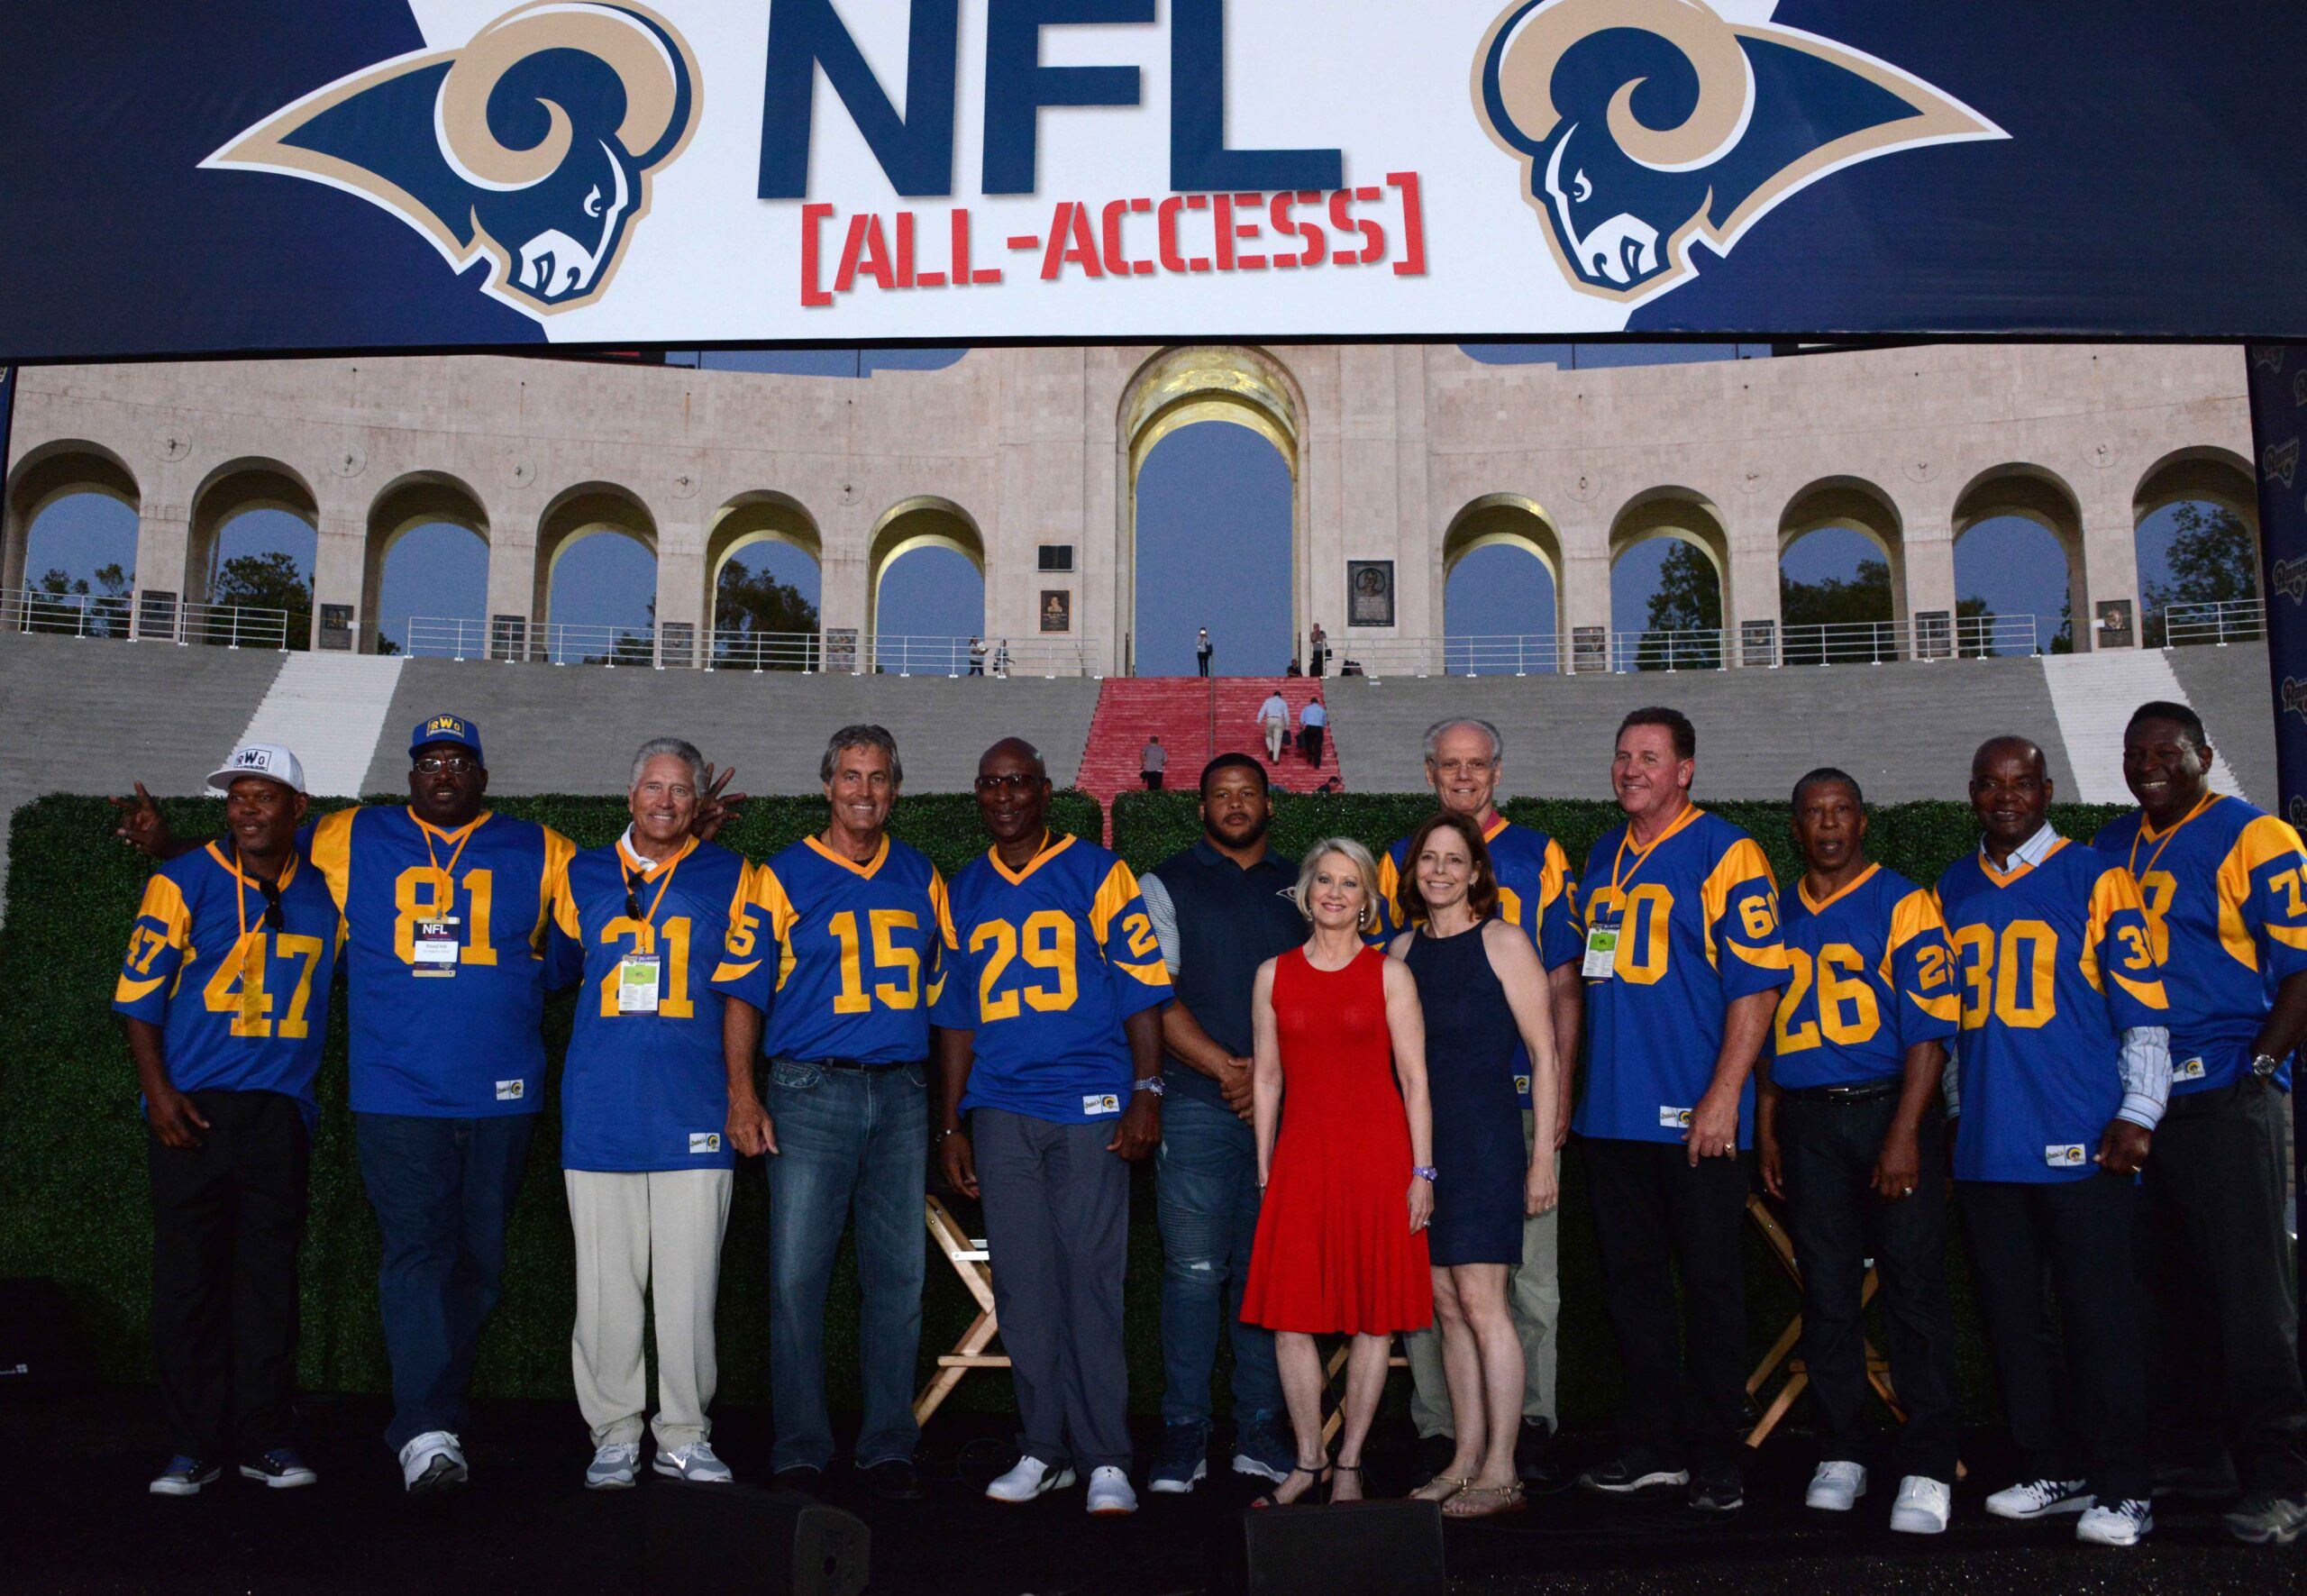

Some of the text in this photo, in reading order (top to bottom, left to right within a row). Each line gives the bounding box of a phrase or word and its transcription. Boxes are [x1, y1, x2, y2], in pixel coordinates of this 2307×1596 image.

[758, 0, 1343, 199] NFL
[127, 925, 169, 975] 47
[394, 866, 497, 965] 81
[423, 924, 448, 935] NFL
[599, 916, 694, 1018] 21
[828, 909, 920, 1014] 15
[969, 909, 1079, 1024] 29
[203, 932, 323, 1038] 47
[1774, 943, 1882, 1056] 26
[1953, 919, 2058, 1030] 30
